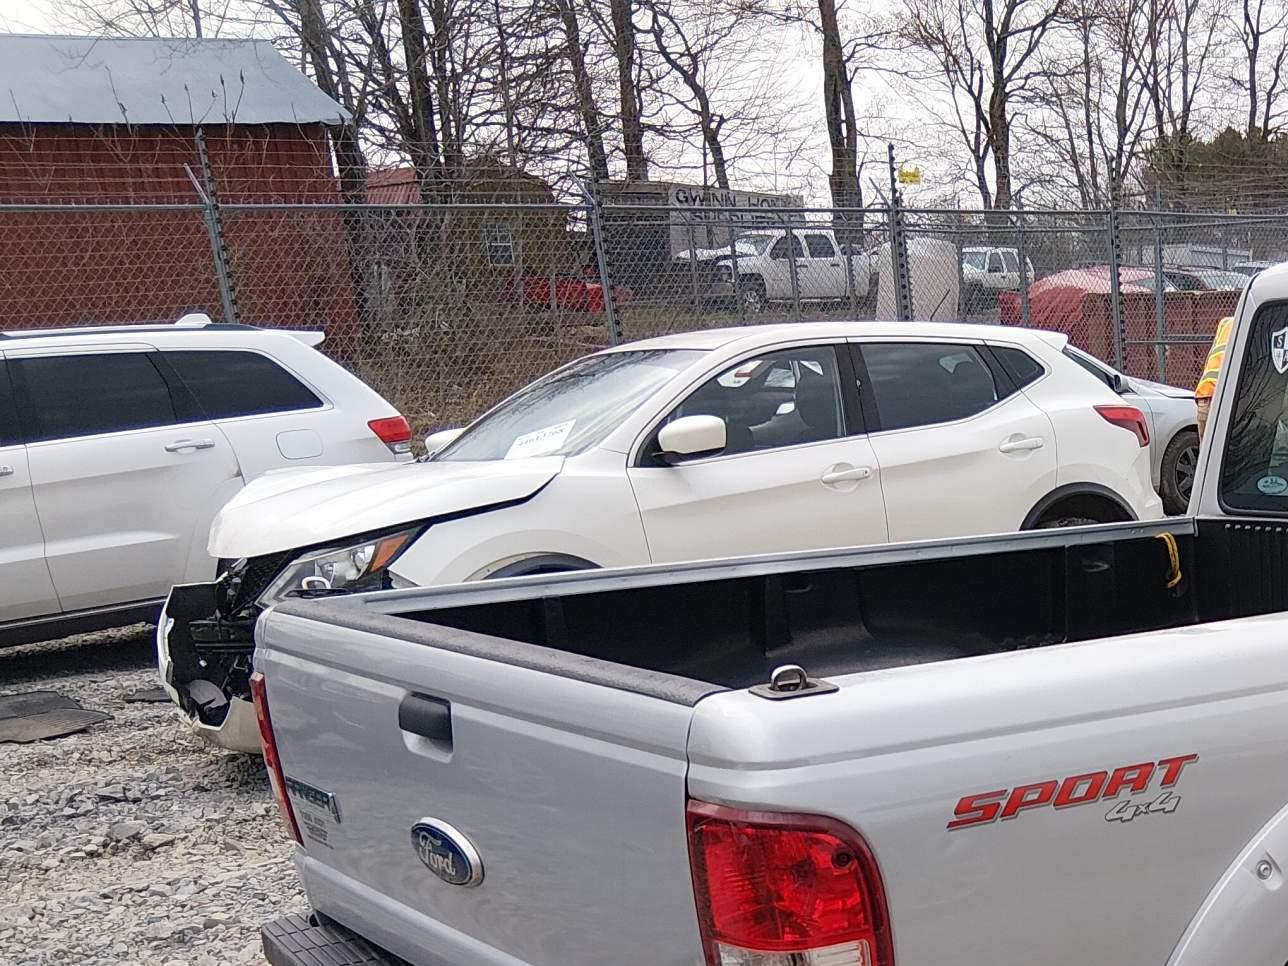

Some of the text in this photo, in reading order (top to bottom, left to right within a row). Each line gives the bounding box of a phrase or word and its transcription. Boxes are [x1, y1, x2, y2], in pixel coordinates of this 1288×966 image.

[1276, 335, 1284, 348] S
[946, 753, 1200, 832] SPORT
[1104, 790, 1182, 824] 4x4
[418, 830, 456, 876] Ford
